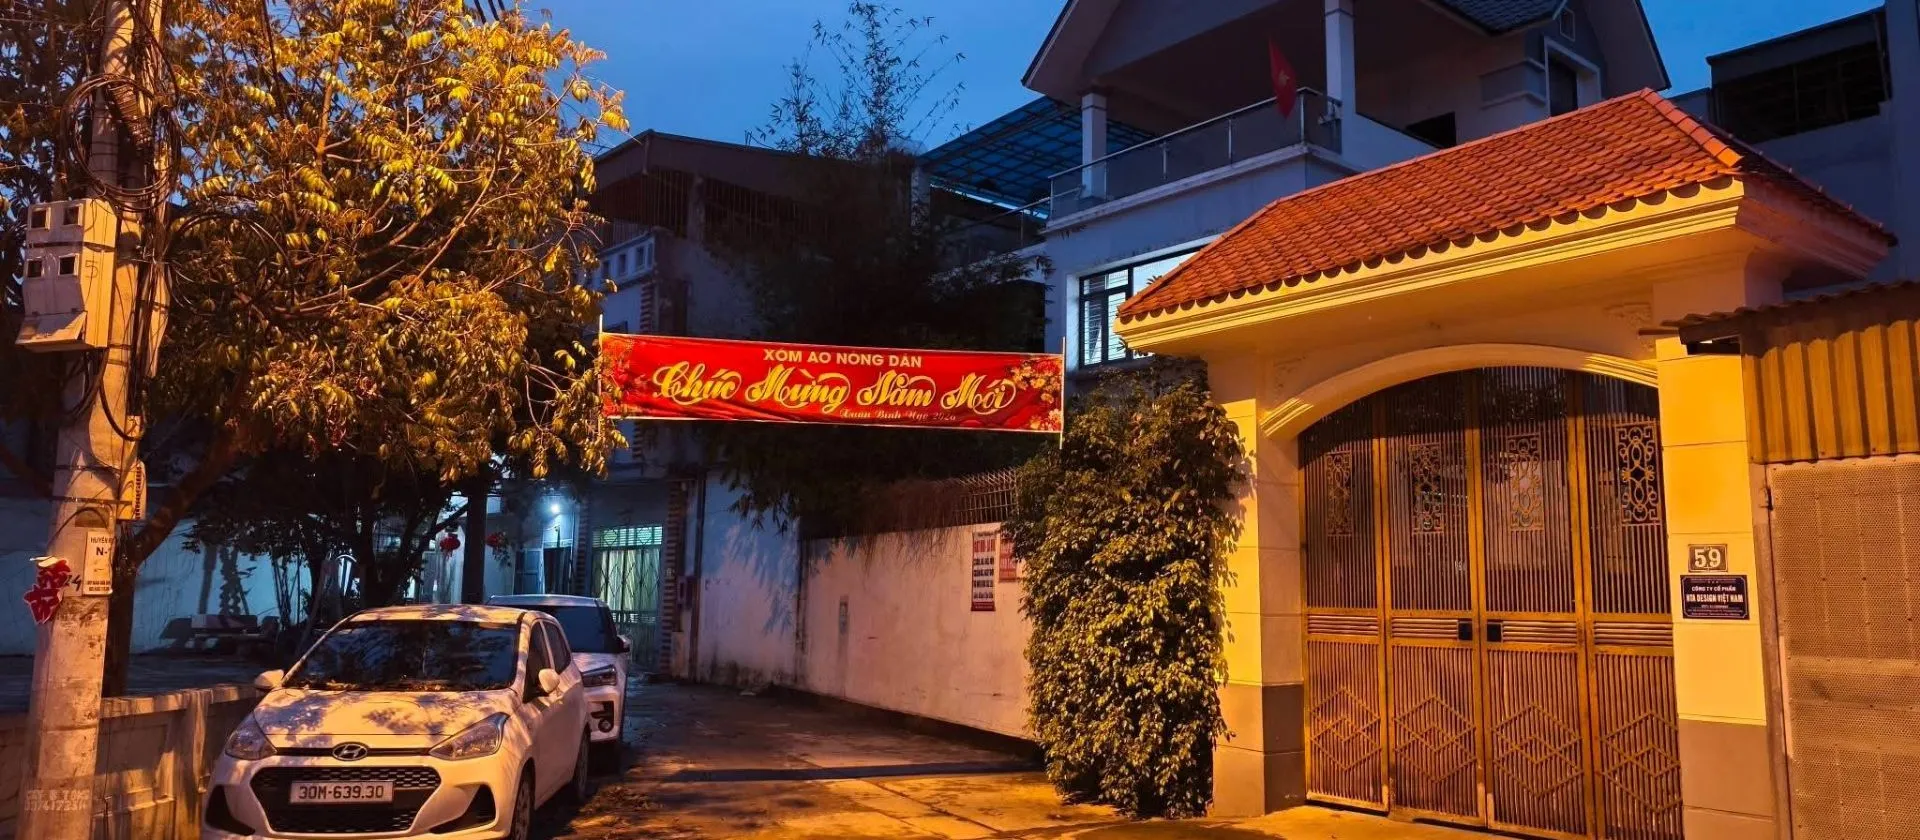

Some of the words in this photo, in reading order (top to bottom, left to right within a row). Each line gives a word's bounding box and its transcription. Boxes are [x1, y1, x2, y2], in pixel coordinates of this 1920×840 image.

[807, 351, 832, 364] AO
[652, 360, 742, 406] Chúc
[744, 363, 851, 414] Mừng
[856, 369, 937, 408] Năm
[1693, 547, 1721, 568] 59
[1696, 593, 1717, 603] DESIGN
[1730, 594, 1744, 603] NAM
[298, 784, 384, 800] 30M-639.30
